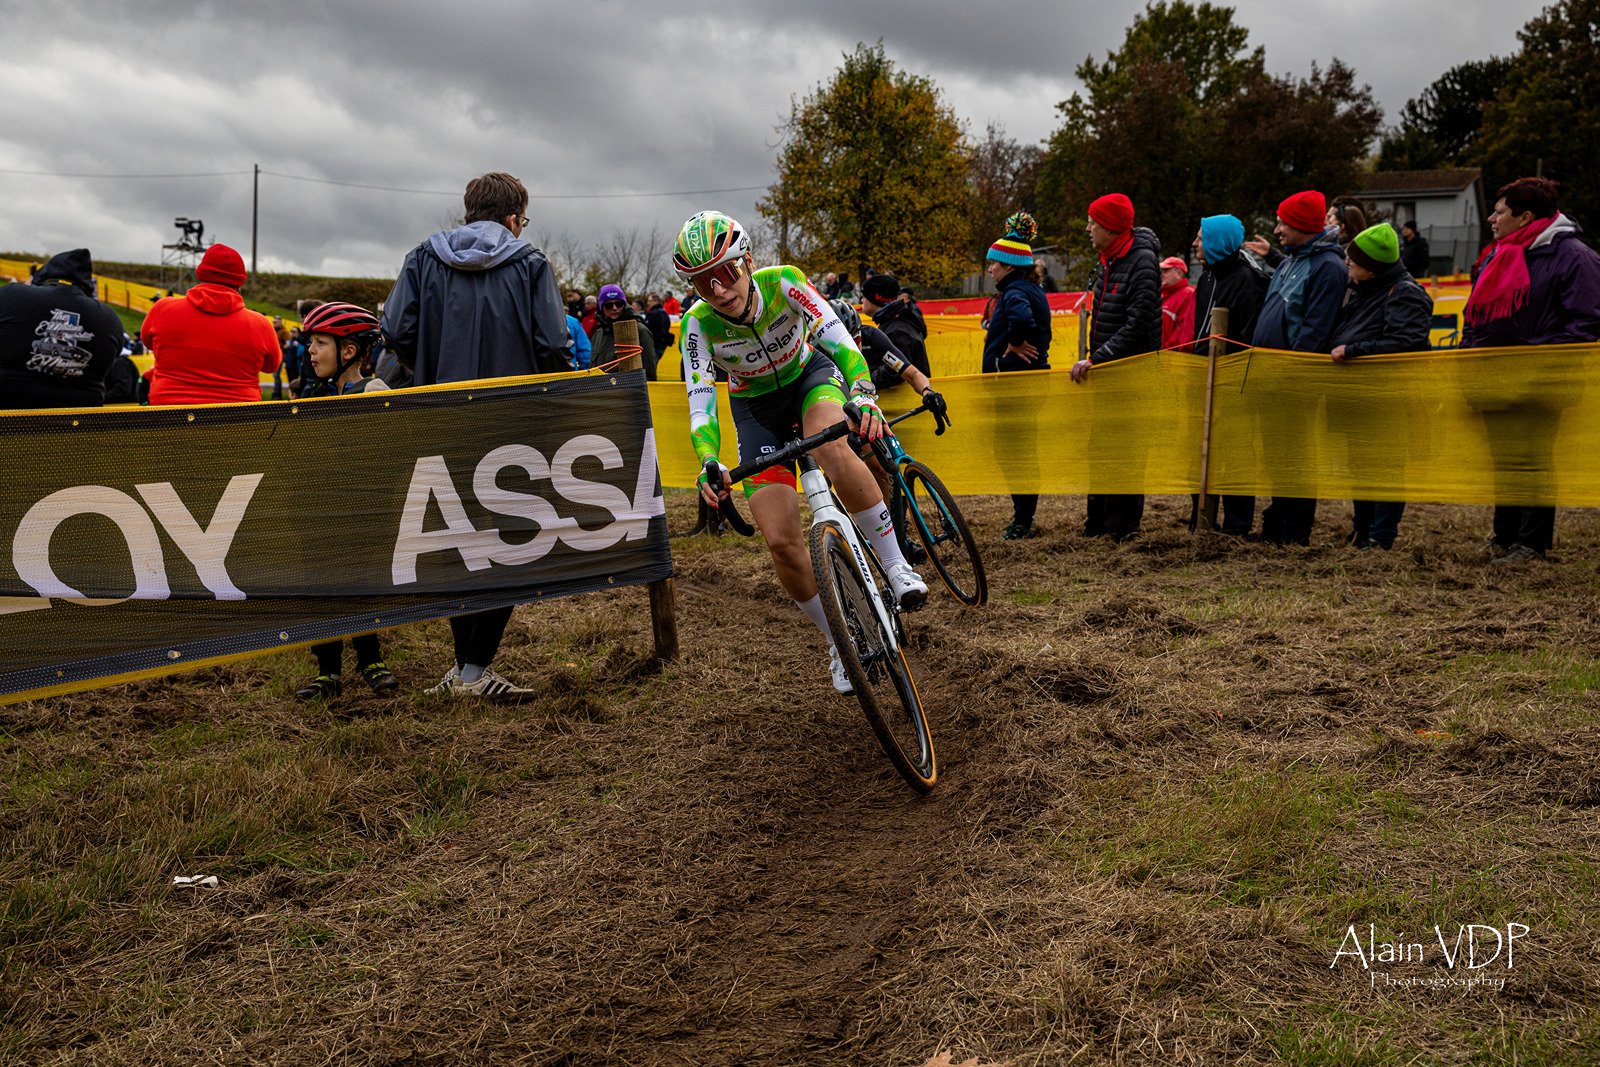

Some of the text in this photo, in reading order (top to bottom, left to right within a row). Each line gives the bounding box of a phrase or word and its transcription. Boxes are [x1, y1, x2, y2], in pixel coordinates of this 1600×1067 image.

[788, 287, 823, 319] corendon
[802, 310, 814, 326] 4
[686, 332, 699, 370] crelan
[731, 338, 801, 377] corendon
[745, 323, 799, 363] crelan
[706, 361, 716, 377] 4
[693, 387, 713, 395] SWISS
[0, 472, 265, 615] OY
[851, 543, 873, 585] STEVENS
